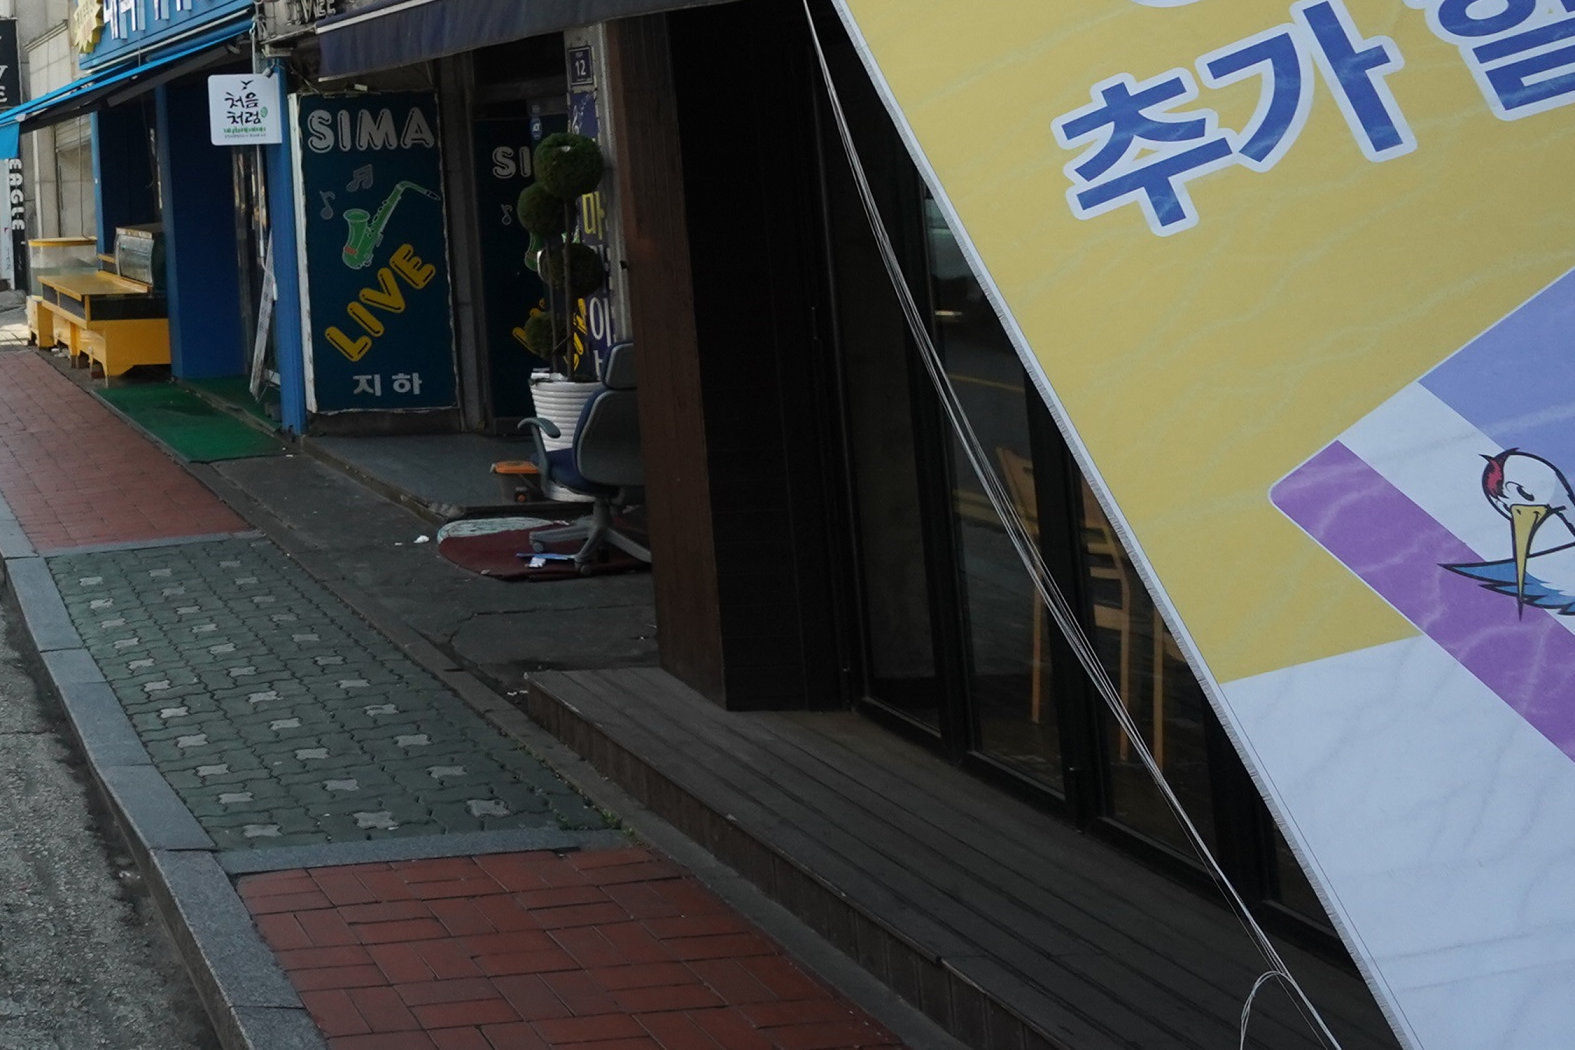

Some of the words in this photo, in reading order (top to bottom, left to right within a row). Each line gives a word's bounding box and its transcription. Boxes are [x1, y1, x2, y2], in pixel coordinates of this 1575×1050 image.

[575, 59, 587, 76] 12
[225, 91, 259, 109] 처음
[1061, 0, 1404, 227] 추가
[227, 110, 261, 126] 처럼
[307, 107, 435, 153] SIMA
[9, 159, 25, 231] EAGLE
[325, 243, 436, 363] LIVE
[352, 372, 423, 397] 지하
